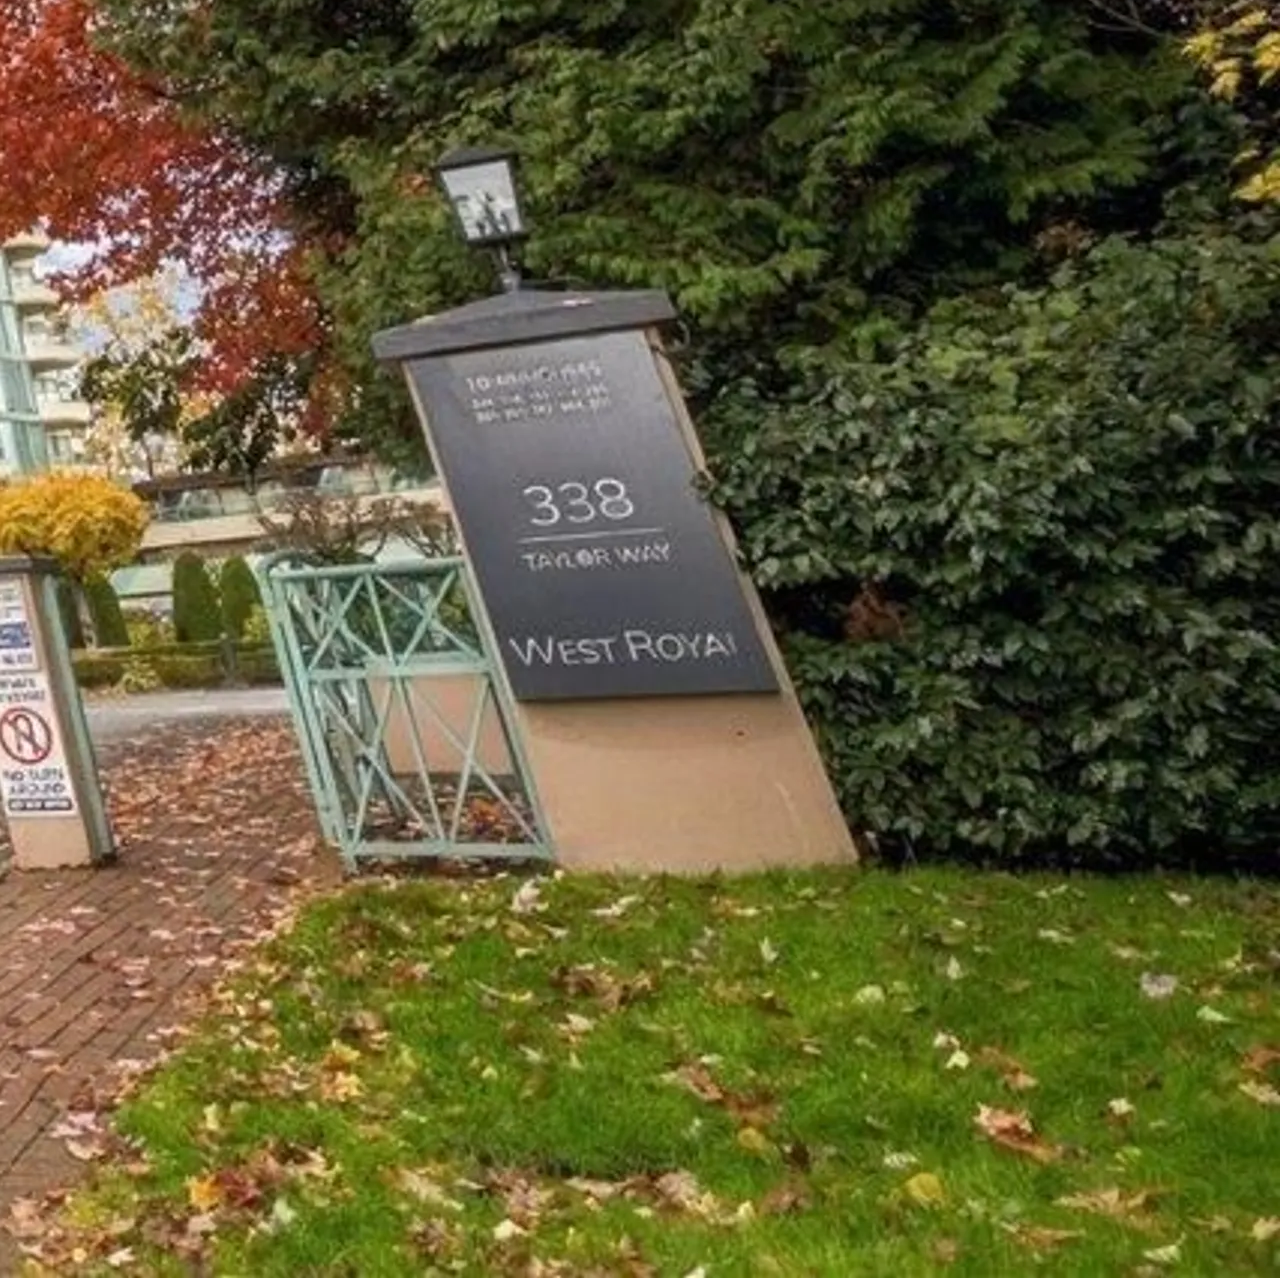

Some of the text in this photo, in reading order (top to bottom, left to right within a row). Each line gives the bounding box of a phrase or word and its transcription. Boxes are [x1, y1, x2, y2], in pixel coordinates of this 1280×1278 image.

[523, 478, 634, 526] 338
[521, 542, 671, 571] TAYLOR WAY
[509, 635, 618, 667] WEST
